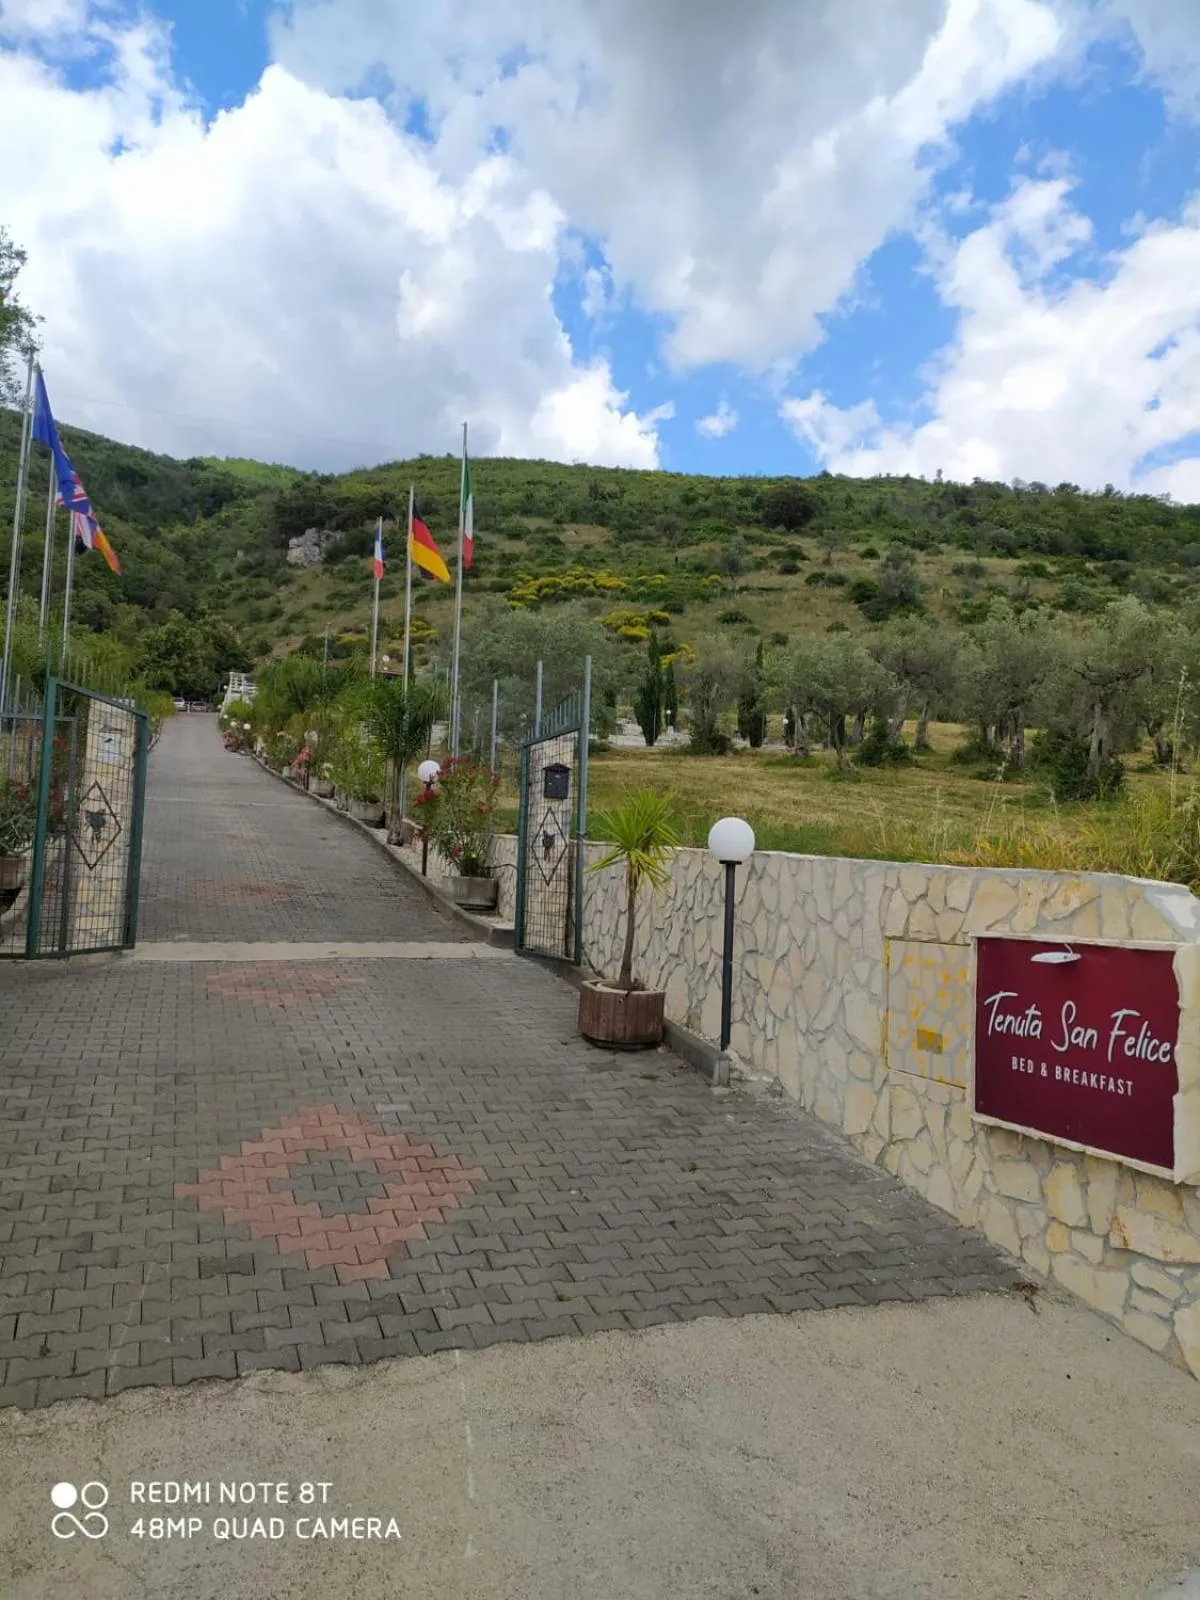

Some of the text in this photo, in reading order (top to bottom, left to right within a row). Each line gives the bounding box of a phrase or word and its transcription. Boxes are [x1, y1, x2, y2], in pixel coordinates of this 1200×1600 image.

[984, 991, 1171, 1063] Tenuta San Felice
[1011, 1056, 1133, 1096] BED & BREAKFAST
